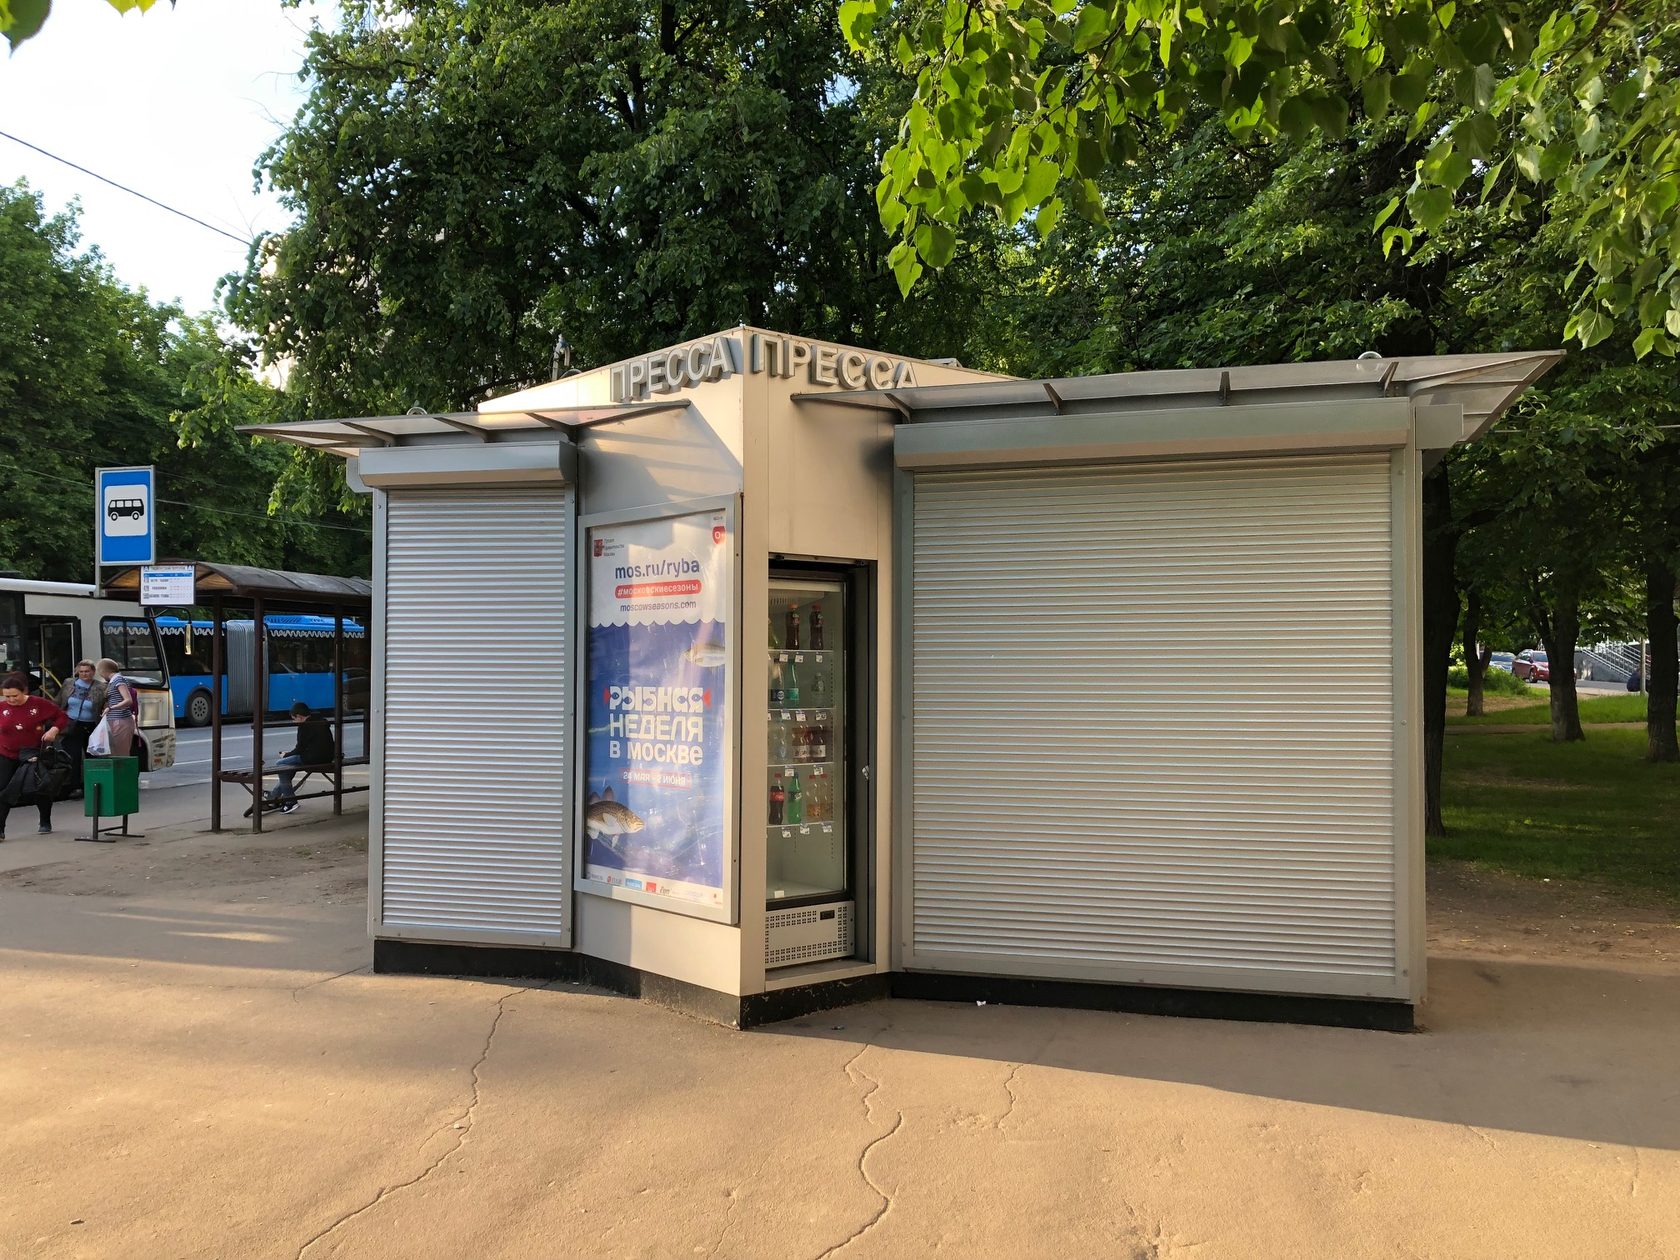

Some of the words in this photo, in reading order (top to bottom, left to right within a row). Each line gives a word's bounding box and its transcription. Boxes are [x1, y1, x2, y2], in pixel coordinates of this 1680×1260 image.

[609, 336, 735, 403] ПРЕССА
[752, 333, 919, 391] ПРЕССА
[615, 558, 700, 579] mos.ru/ryba
[620, 600, 697, 612] moscowseasons.com
[609, 713, 703, 742] НЕДЕЛЯ
[623, 771, 633, 781] 24
